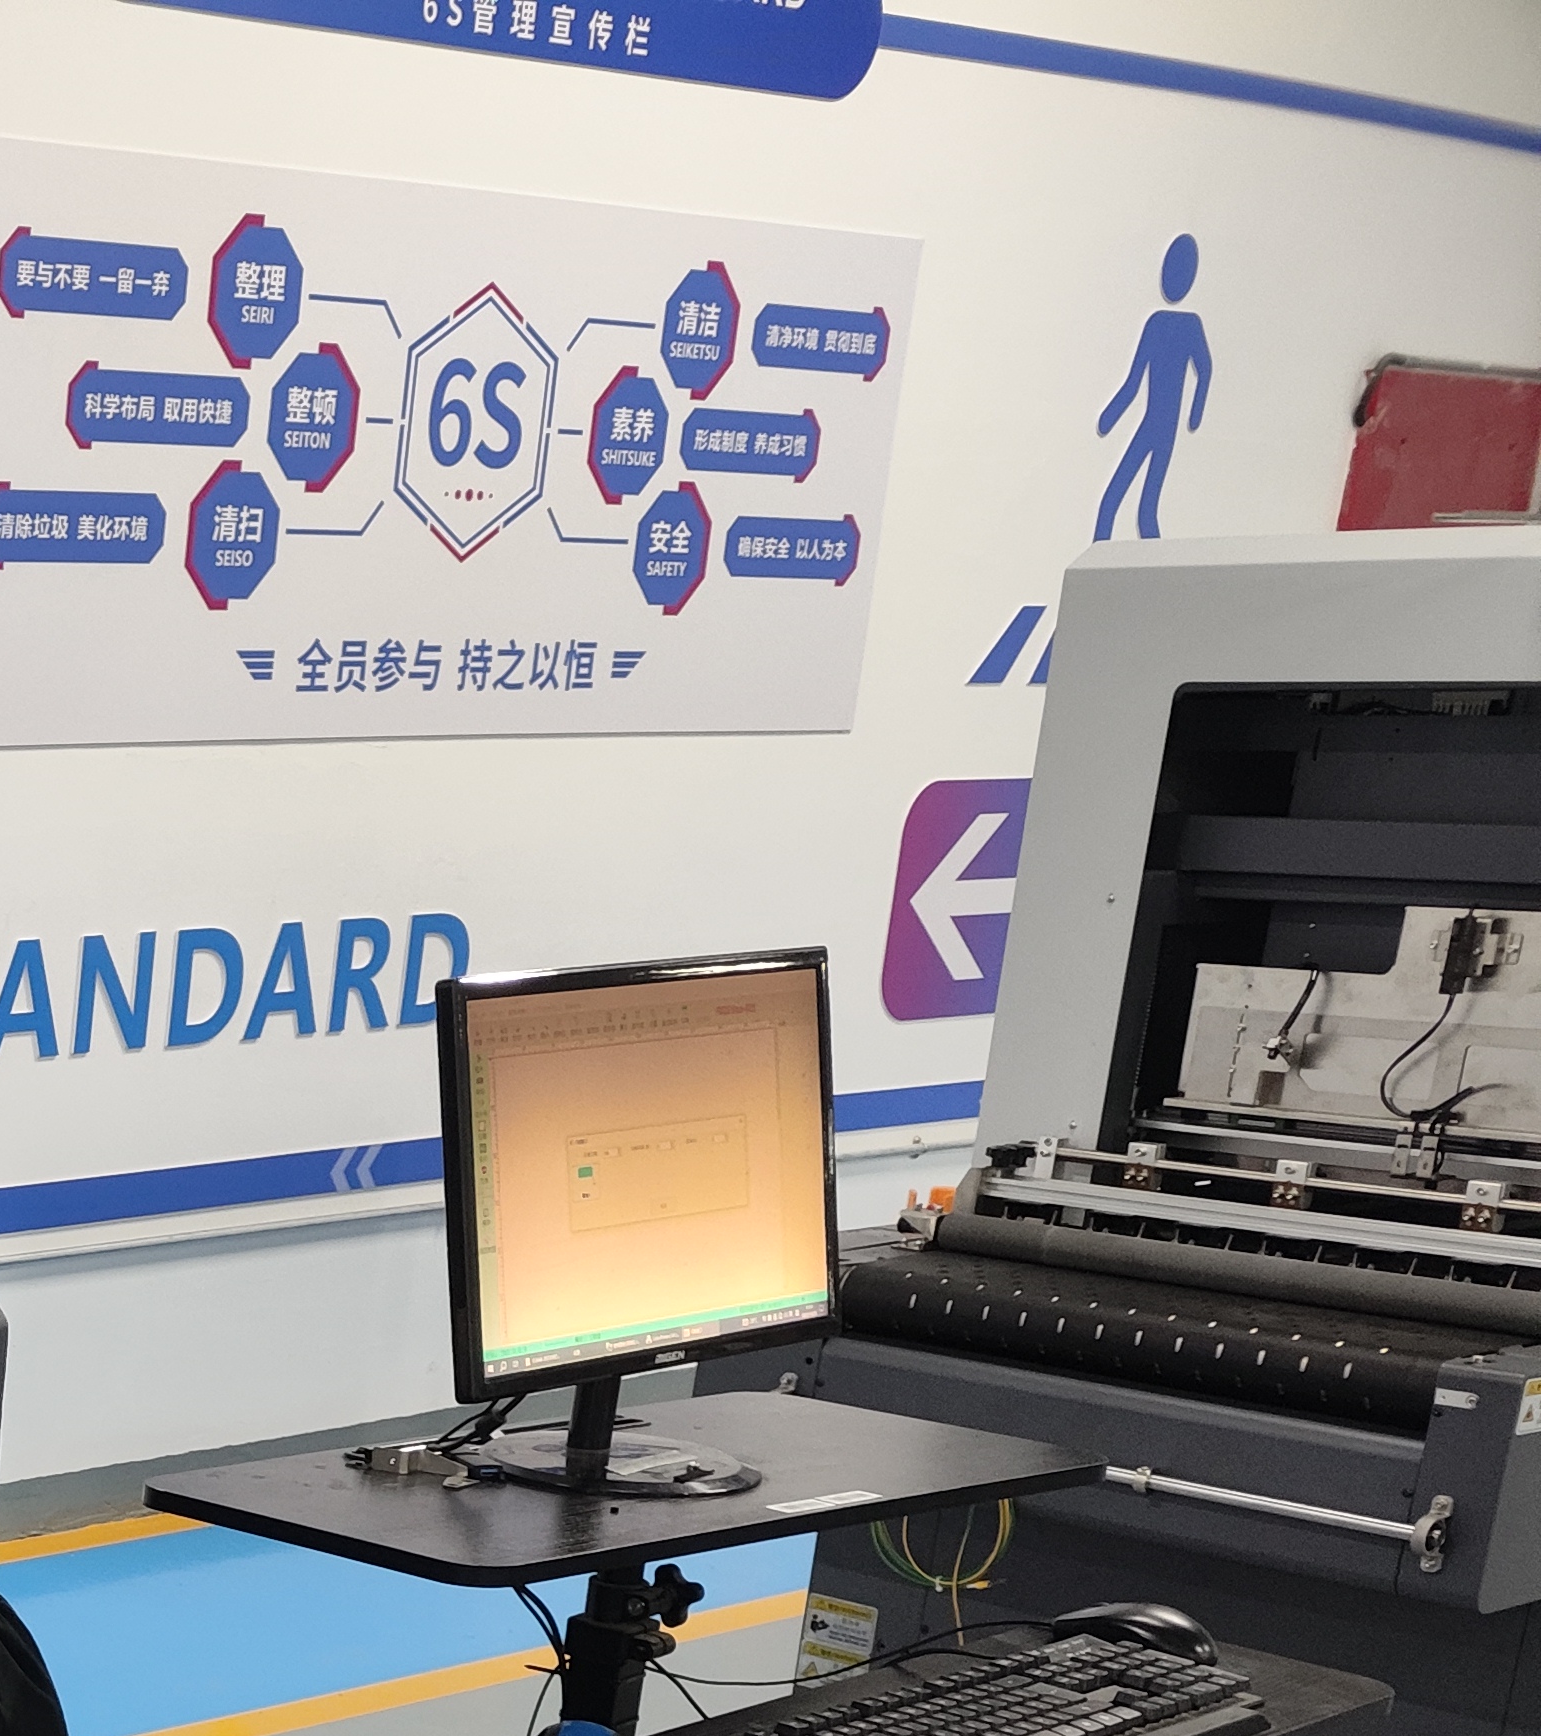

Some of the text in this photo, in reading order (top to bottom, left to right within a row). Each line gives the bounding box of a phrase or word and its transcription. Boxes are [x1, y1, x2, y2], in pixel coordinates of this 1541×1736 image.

[17, 260, 171, 296] 要与不要 一留一弃
[234, 262, 286, 301] 整理
[241, 305, 274, 325] SEIRI
[676, 301, 721, 338] 清洁
[669, 341, 720, 361] SEIKETSU
[824, 327, 876, 355] 贯彻到底
[85, 394, 233, 425] 科学布局 取用快捷
[287, 387, 338, 425] 整顿
[429, 357, 527, 469] 6S
[610, 406, 654, 442] 素养
[284, 431, 331, 449] SEITON
[693, 429, 806, 458] 形成制度 养成习惯
[601, 448, 656, 467] SHITSUKE
[77, 515, 148, 542] 美化环境
[212, 506, 265, 544] 清扫
[649, 521, 692, 555] 安全
[215, 550, 253, 567] SEISO
[738, 537, 847, 562] 确保安全 以人为本
[646, 561, 687, 577] SAFETY
[296, 638, 598, 693] 全员参与 持之以恒
